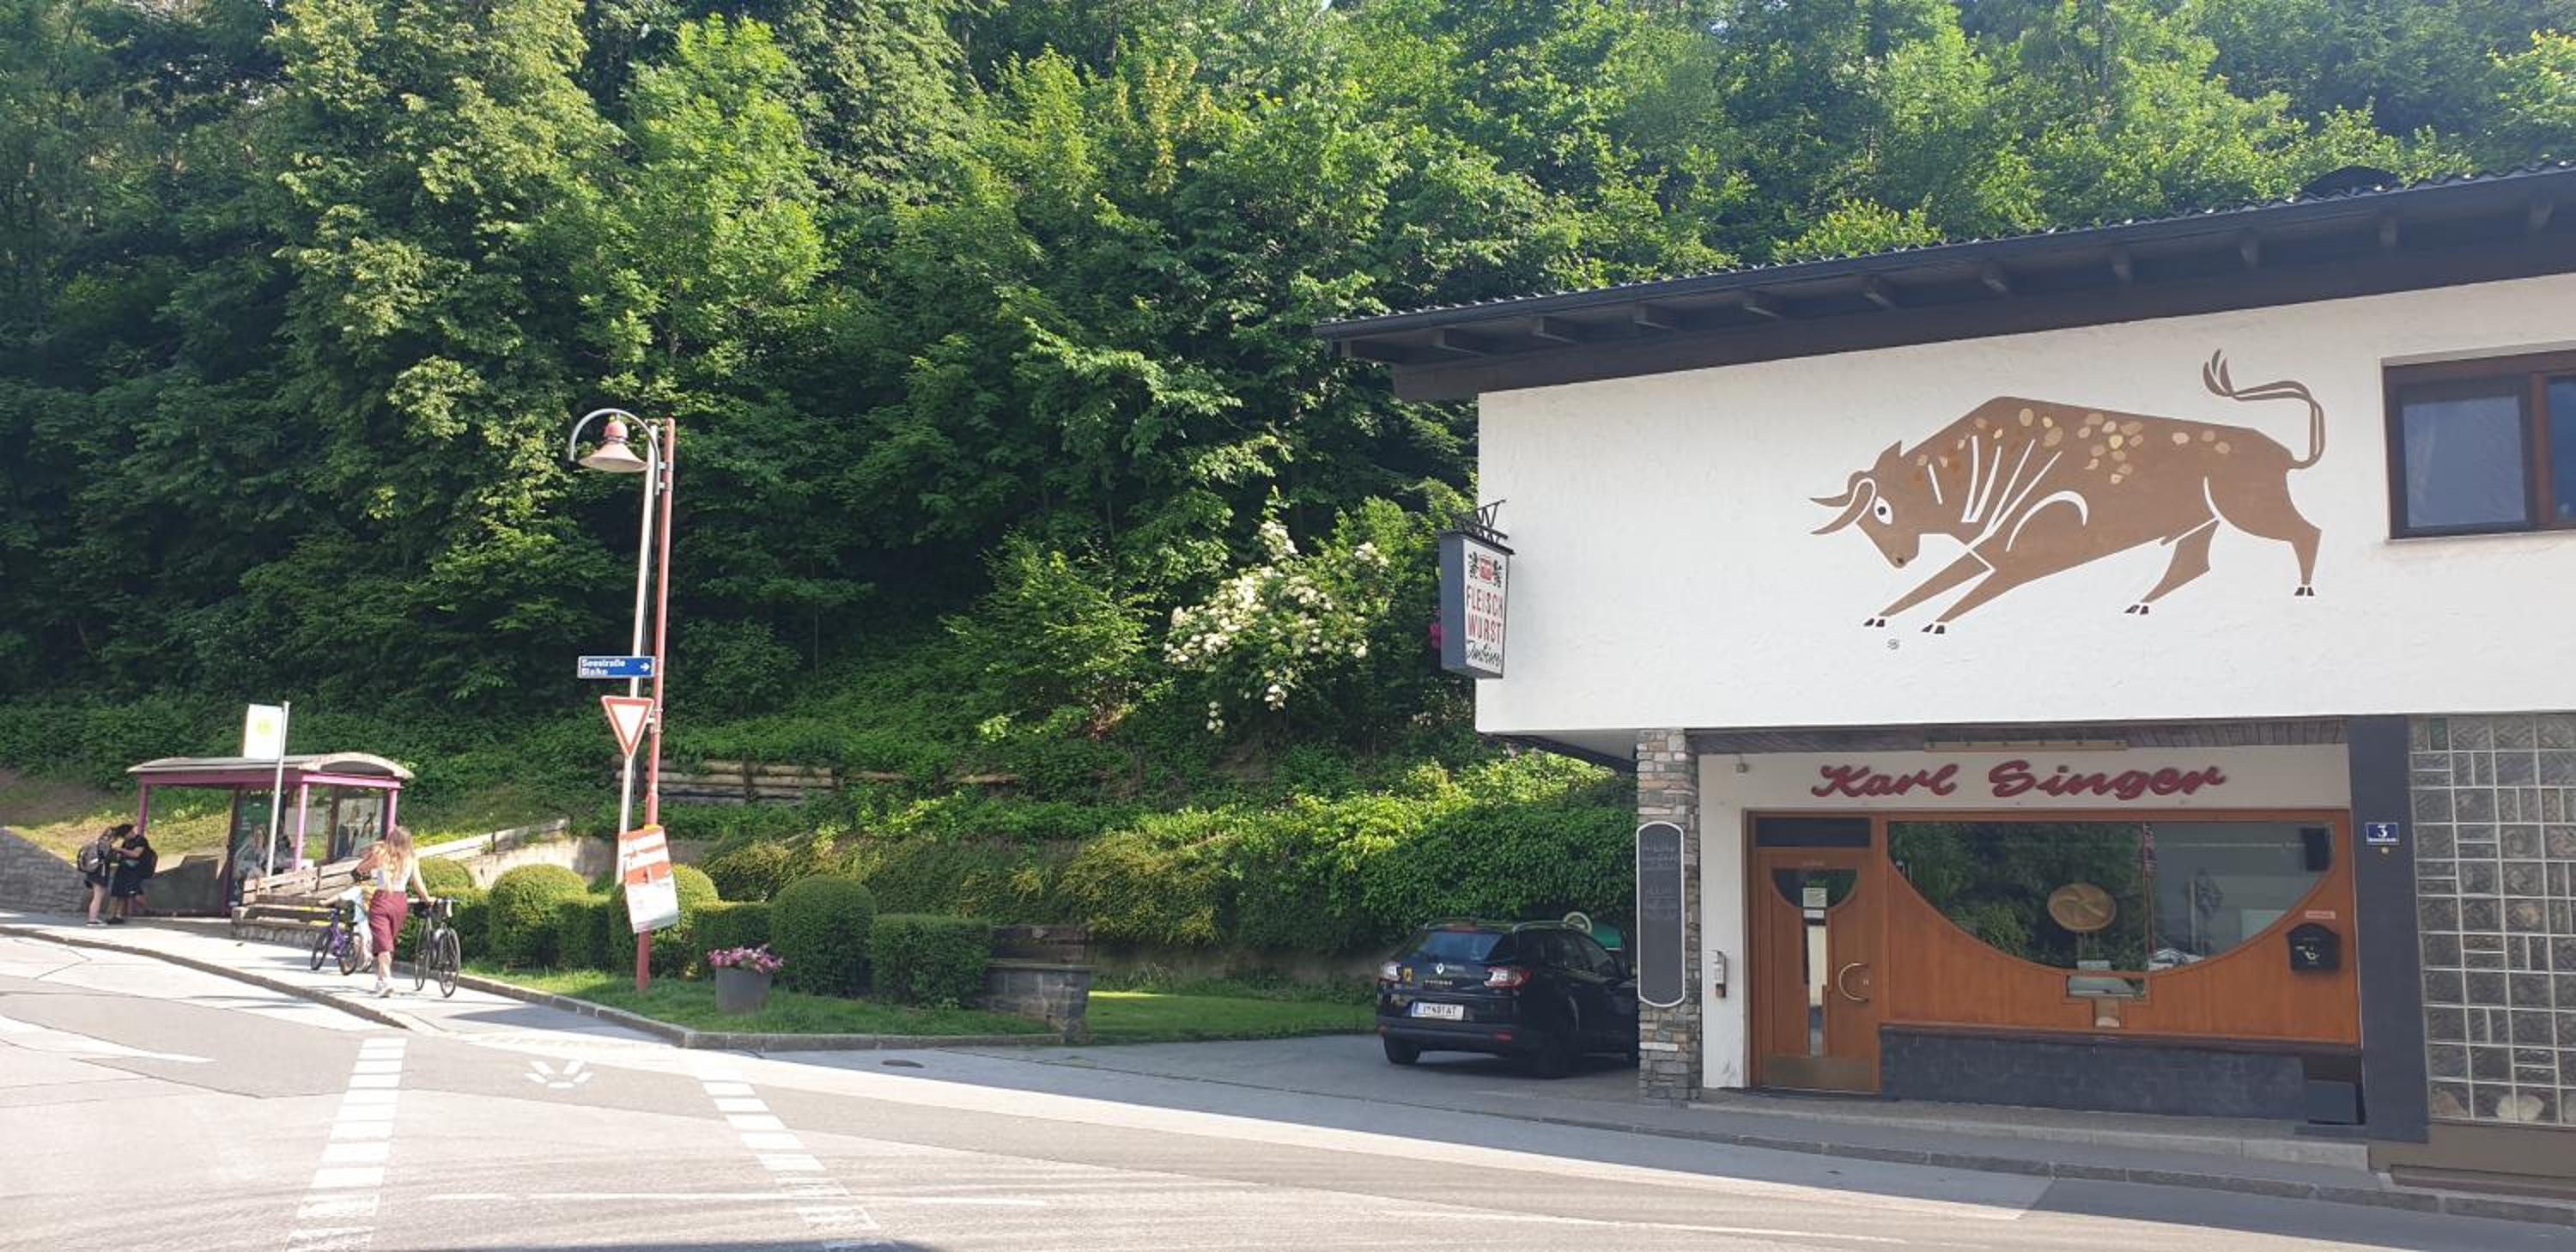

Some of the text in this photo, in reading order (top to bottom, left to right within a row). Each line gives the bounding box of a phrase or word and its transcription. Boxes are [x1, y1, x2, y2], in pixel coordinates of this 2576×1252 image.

[1466, 585, 1504, 619] FLEISCH
[1467, 612, 1502, 645] WURST
[581, 659, 626, 667] Seestraße
[1811, 759, 2227, 800] Karl Singer
[2376, 824, 2388, 838] 3
